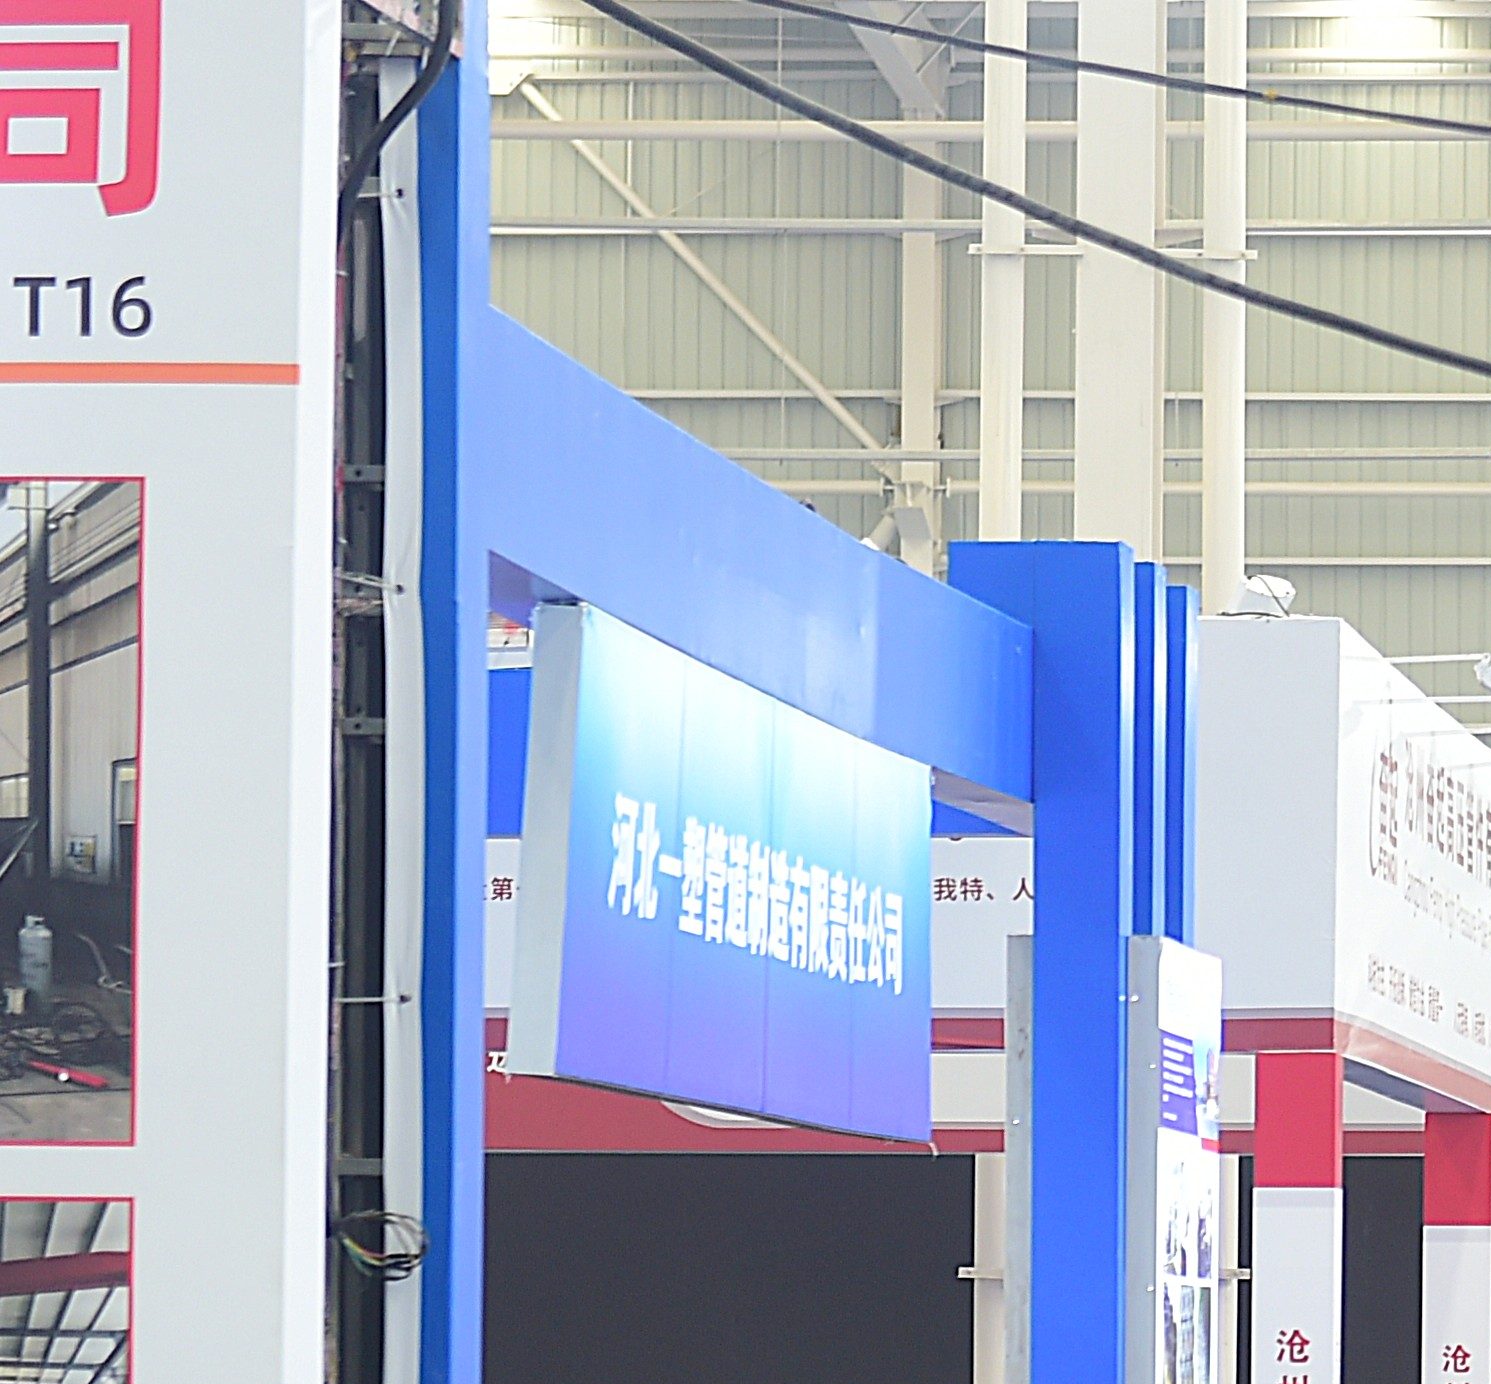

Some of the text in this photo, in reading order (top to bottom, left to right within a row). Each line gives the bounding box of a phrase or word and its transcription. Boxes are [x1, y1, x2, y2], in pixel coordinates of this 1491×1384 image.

[14, 276, 153, 337] T16
[606, 792, 904, 997] 河北一塑管道制造有限责任公司
